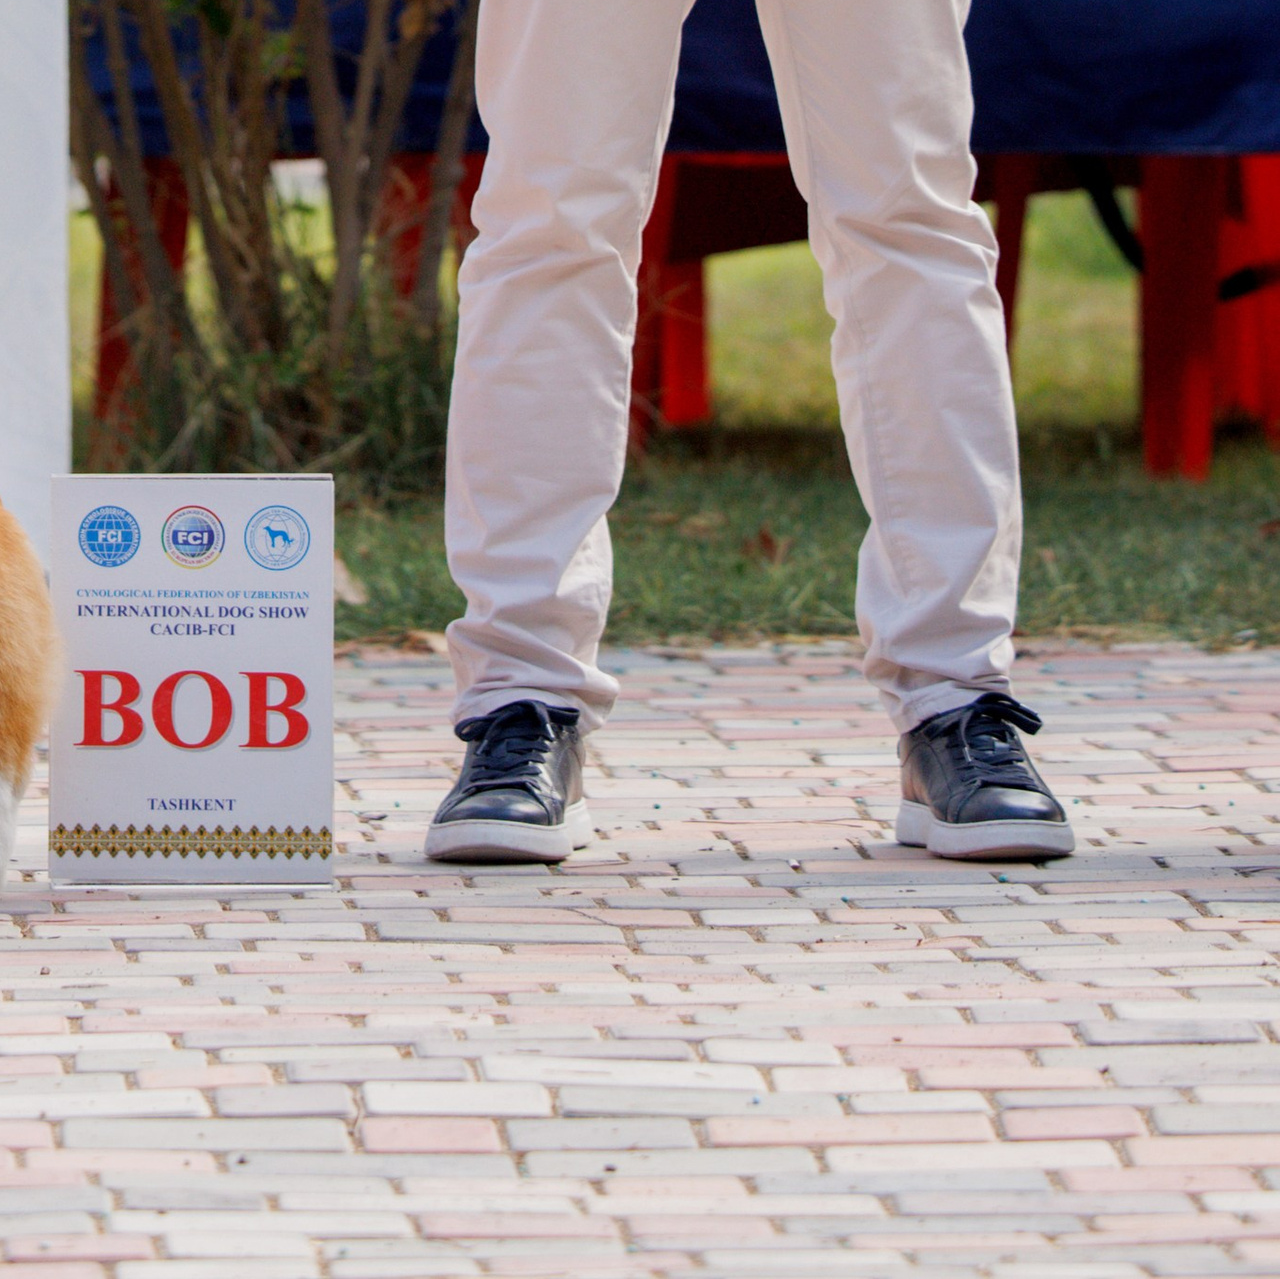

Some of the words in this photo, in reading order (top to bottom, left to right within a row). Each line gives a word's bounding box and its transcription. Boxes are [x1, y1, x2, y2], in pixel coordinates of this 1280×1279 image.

[98, 530, 122, 543] FCI
[177, 531, 209, 545] FCI
[76, 589, 155, 598] CYNOLOGICAL
[157, 589, 224, 599] FEDERATION
[227, 590, 241, 599] OF
[243, 590, 310, 600] UZBEKISTAN
[77, 604, 215, 618] INTERNATIONAL
[218, 606, 255, 619] DOG
[258, 606, 309, 619] SHOW
[150, 623, 236, 636] CACIB-FCI
[73, 670, 310, 750] BOB
[147, 798, 237, 812] TASHKENT
